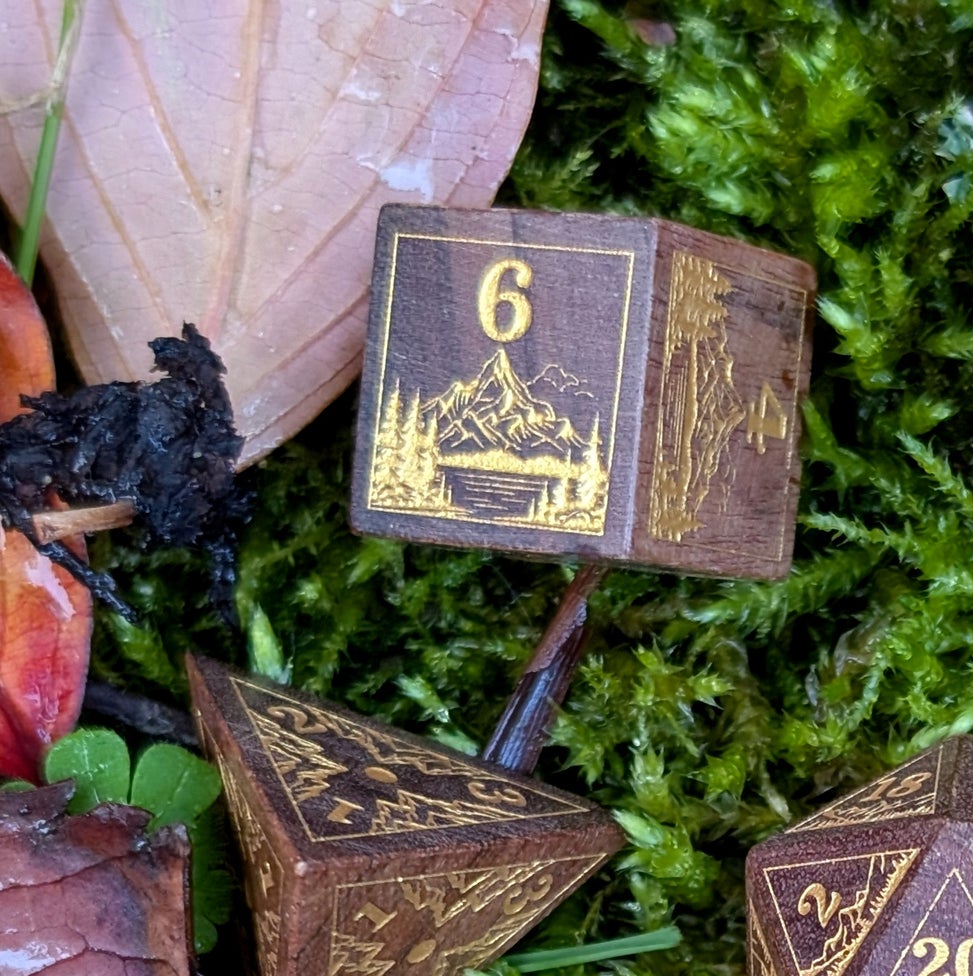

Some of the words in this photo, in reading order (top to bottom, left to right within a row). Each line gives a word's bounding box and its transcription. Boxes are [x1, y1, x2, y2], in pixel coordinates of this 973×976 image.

[478, 259, 533, 342] 6
[747, 382, 787, 454] 4
[267, 706, 329, 735] 2
[468, 780, 526, 807] 3
[860, 772, 932, 802] 18
[327, 797, 365, 825] 1
[503, 873, 554, 916] 3
[798, 882, 844, 928] 2
[353, 901, 399, 933] 1
